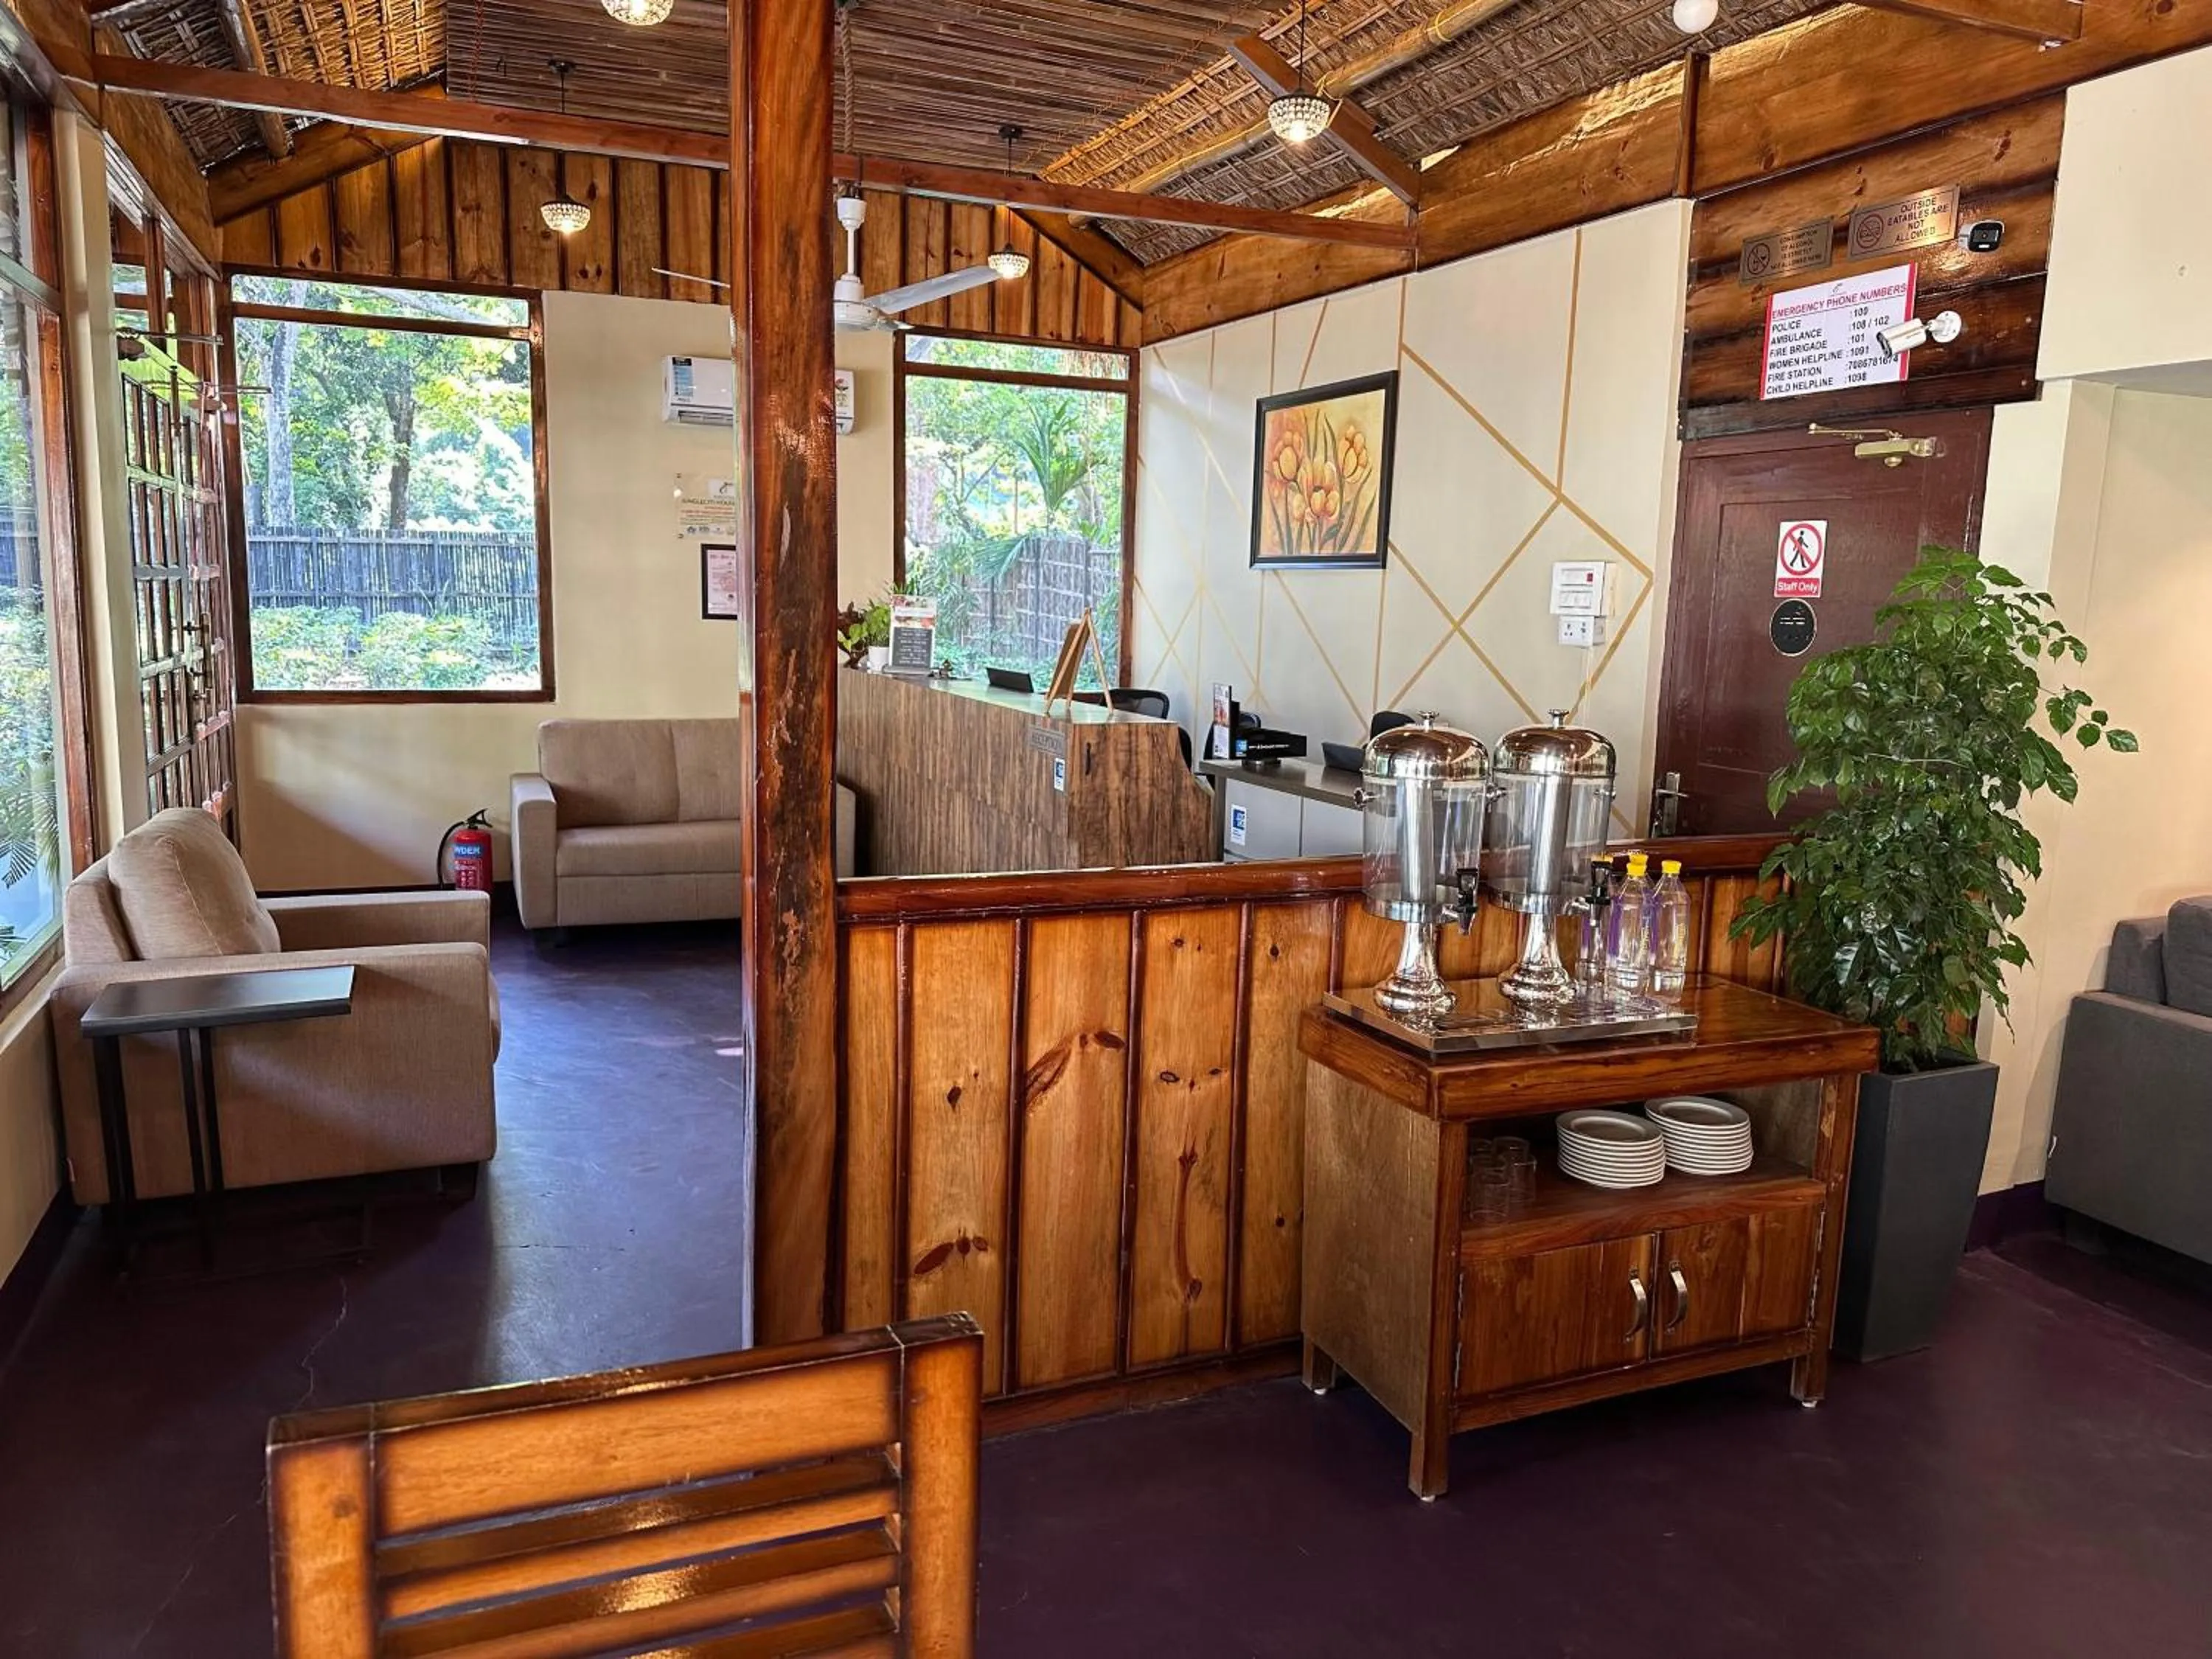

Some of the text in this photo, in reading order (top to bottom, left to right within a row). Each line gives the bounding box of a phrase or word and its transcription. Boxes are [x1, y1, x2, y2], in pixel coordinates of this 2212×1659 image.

[1901, 196, 1936, 213] OUTSIDE
[1888, 203, 1950, 226] EATABLES ARE
[1908, 219, 1924, 230] NOT
[1894, 226, 1935, 243] ALLOWED
[1772, 283, 1907, 319] EMERGENCY PHONE NUMBERS
[1771, 328, 1823, 345] AMBULANCE
[1874, 316, 1890, 327] 102
[1772, 319, 1801, 333] POLICE
[1770, 347, 1787, 357] FIRE
[1790, 340, 1828, 355] BRIGADE
[1769, 358, 1800, 370] WOMEN
[1801, 349, 1843, 365] HELPLINE
[1767, 372, 1785, 383] FIRE
[1787, 366, 1822, 380] STATION
[1766, 383, 1791, 394] CHILD
[1792, 377, 1834, 391] HELPLINE
[1778, 582, 1818, 594] Staff Only
